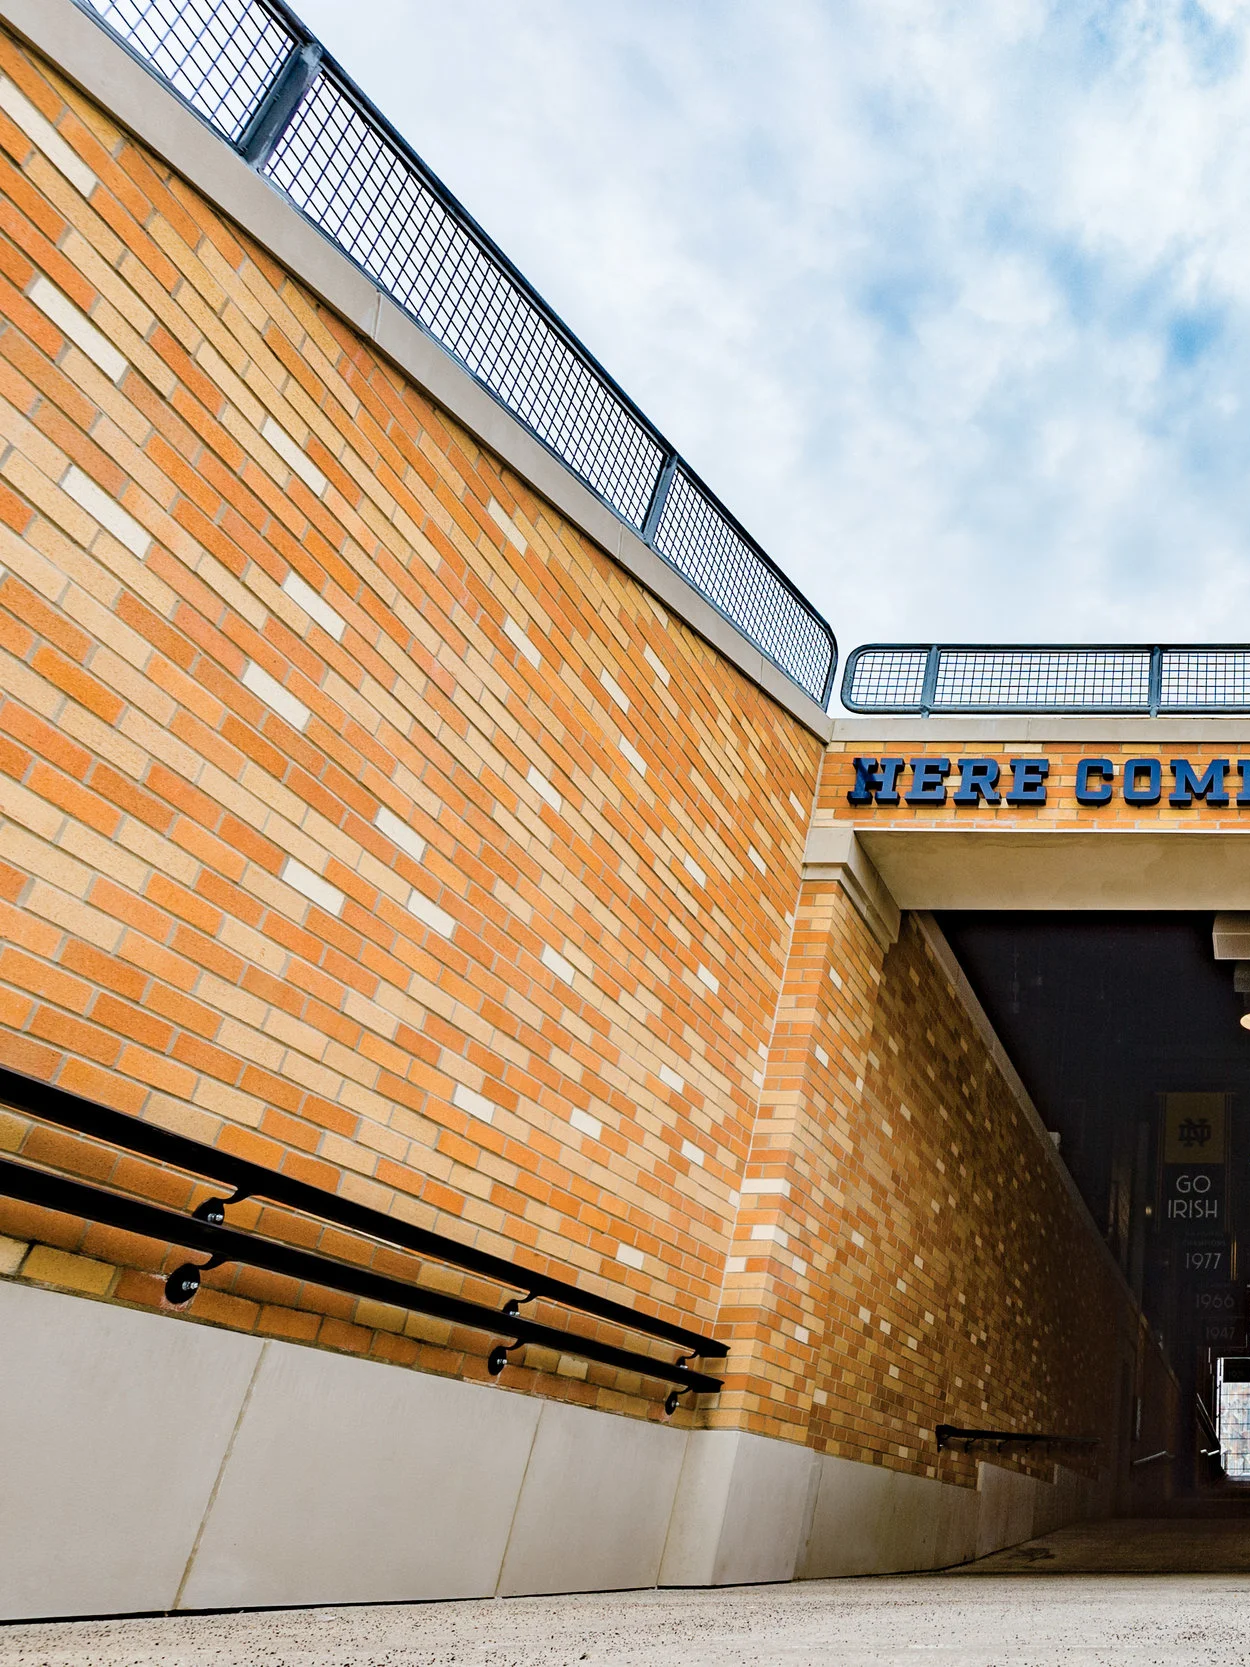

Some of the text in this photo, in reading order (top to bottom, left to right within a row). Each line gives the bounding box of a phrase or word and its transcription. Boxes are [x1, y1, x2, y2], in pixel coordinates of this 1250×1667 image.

[847, 757, 1049, 806] HERE
[1175, 1174, 1213, 1194] GO
[1167, 1199, 1218, 1219] IRISH
[1185, 1252, 1222, 1270] 1977
[1196, 1293, 1235, 1310] 1966
